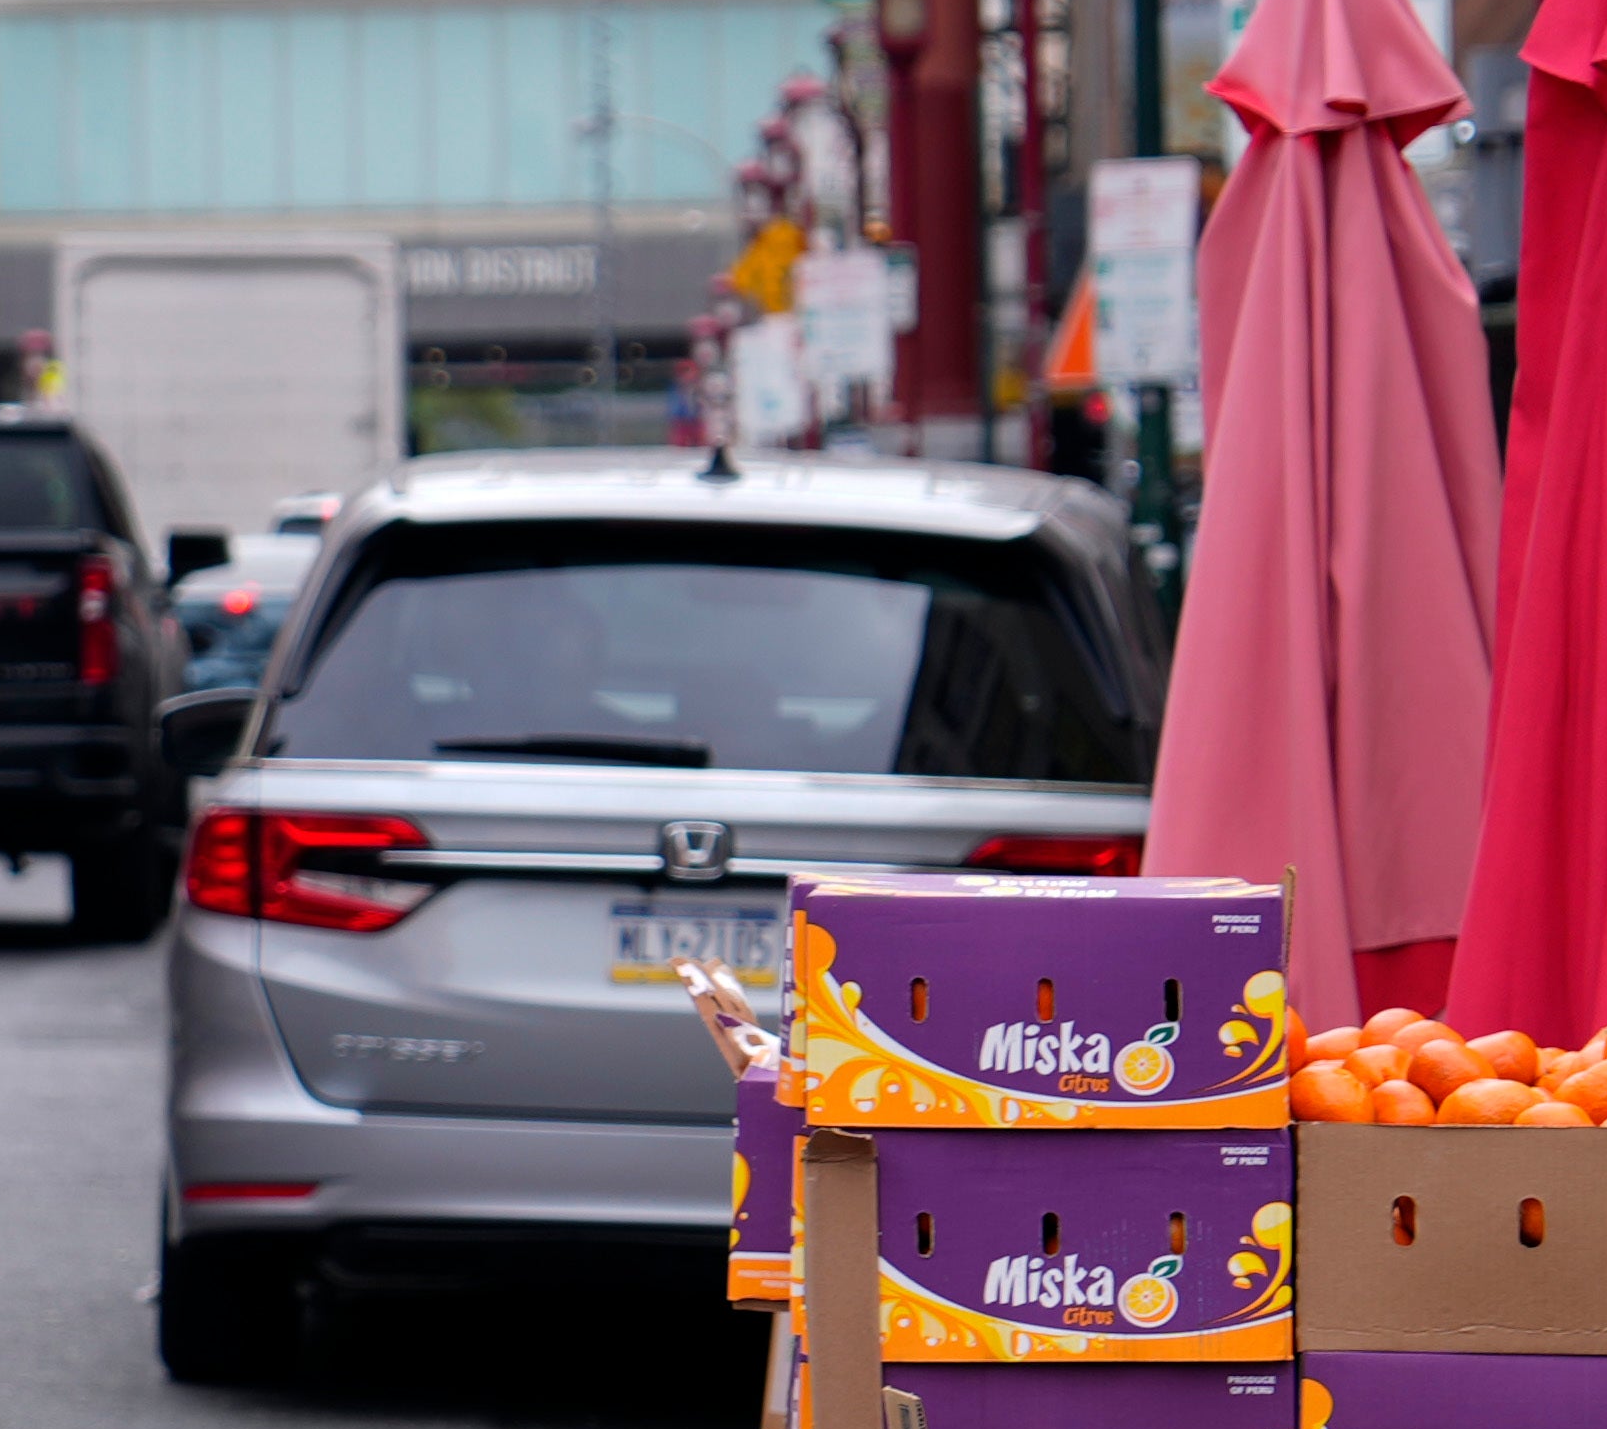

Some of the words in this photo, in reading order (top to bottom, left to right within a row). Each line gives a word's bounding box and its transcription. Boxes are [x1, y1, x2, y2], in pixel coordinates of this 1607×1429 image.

[1212, 913, 1262, 925] PRODUCE
[1214, 924, 1227, 934] OF
[1229, 924, 1259, 934] PERU
[979, 1020, 1111, 1073] Miska
[1058, 1073, 1110, 1094] Citrus
[1220, 1146, 1270, 1157] PRODUCE
[1223, 1156, 1236, 1166] OF
[1238, 1156, 1267, 1167] PERU
[983, 1254, 1115, 1308] Miska
[1062, 1306, 1114, 1327] Citrus
[1227, 1375, 1277, 1386] PRODUCE
[1229, 1386, 1242, 1396] OF
[1245, 1386, 1275, 1396] PERU
